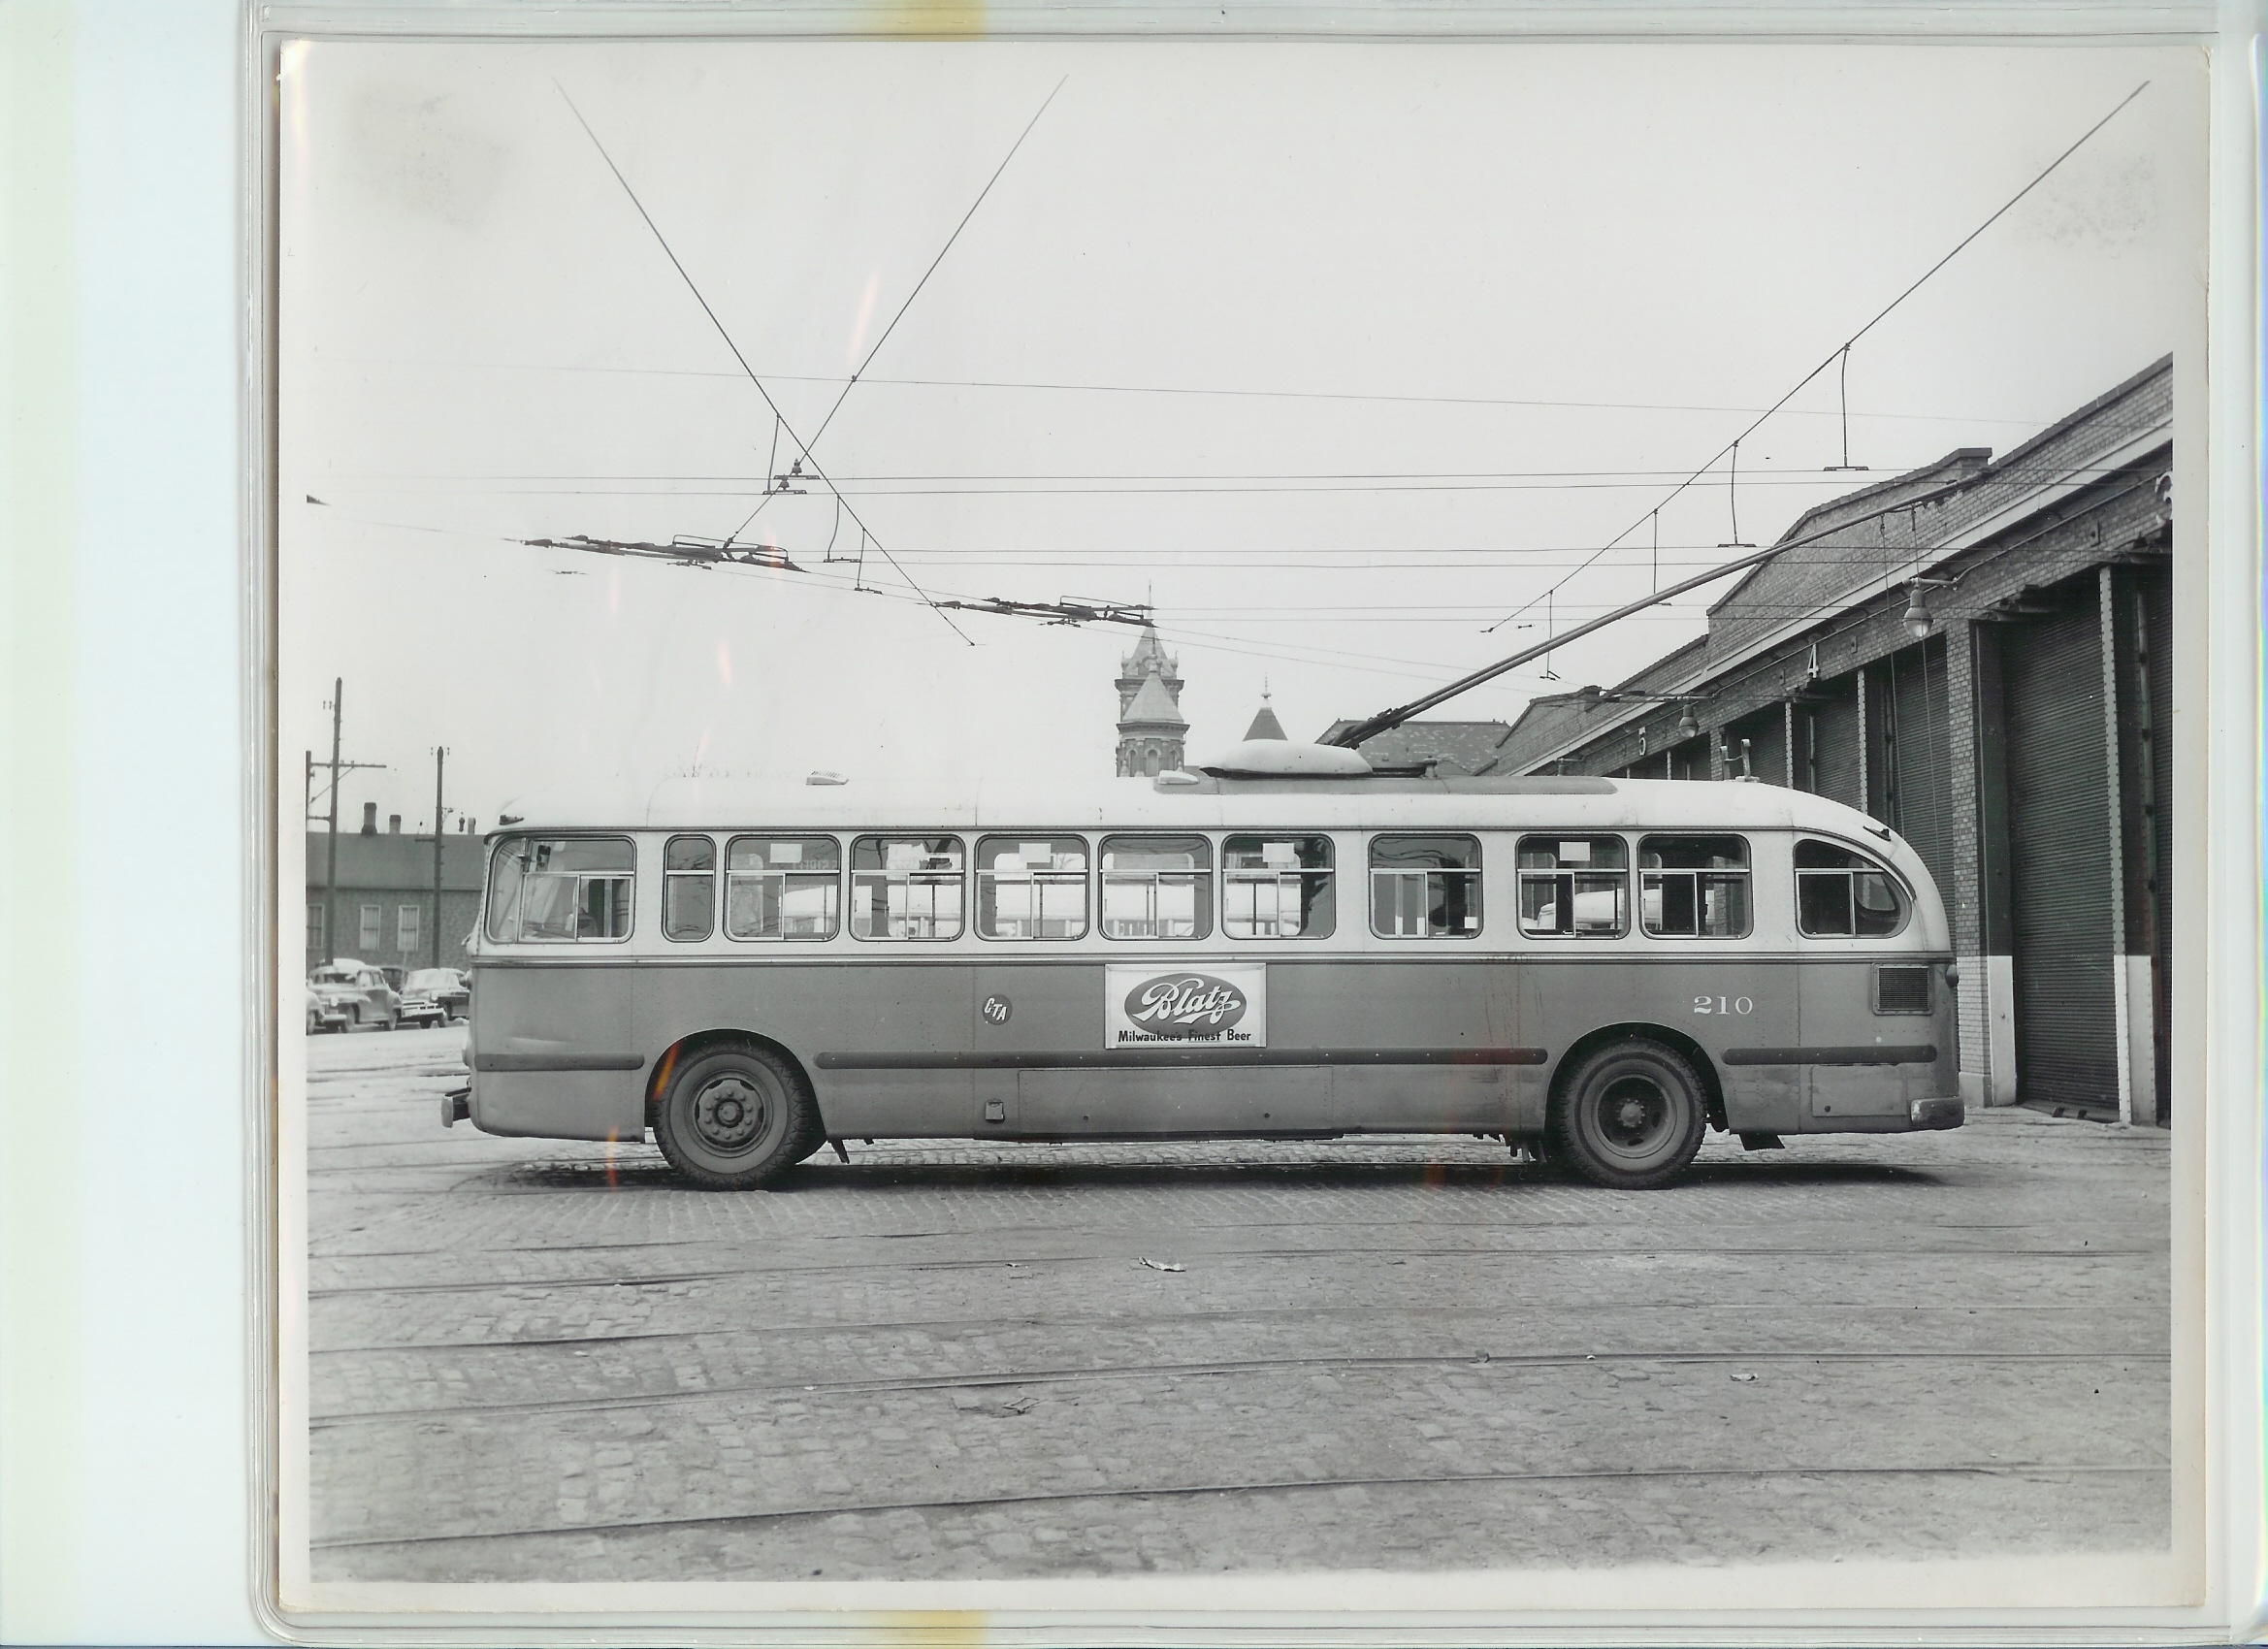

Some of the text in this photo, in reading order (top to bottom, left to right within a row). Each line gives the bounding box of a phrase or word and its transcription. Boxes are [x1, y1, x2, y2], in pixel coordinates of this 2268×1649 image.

[1807, 643, 1819, 678] 4
[1638, 726, 1647, 756] 5
[984, 997, 1007, 1020] CTA
[1132, 978, 1241, 1024] Blatz
[1694, 995, 1753, 1015] 210
[1118, 1028, 1251, 1043] Milwaukee's Finest Beer
